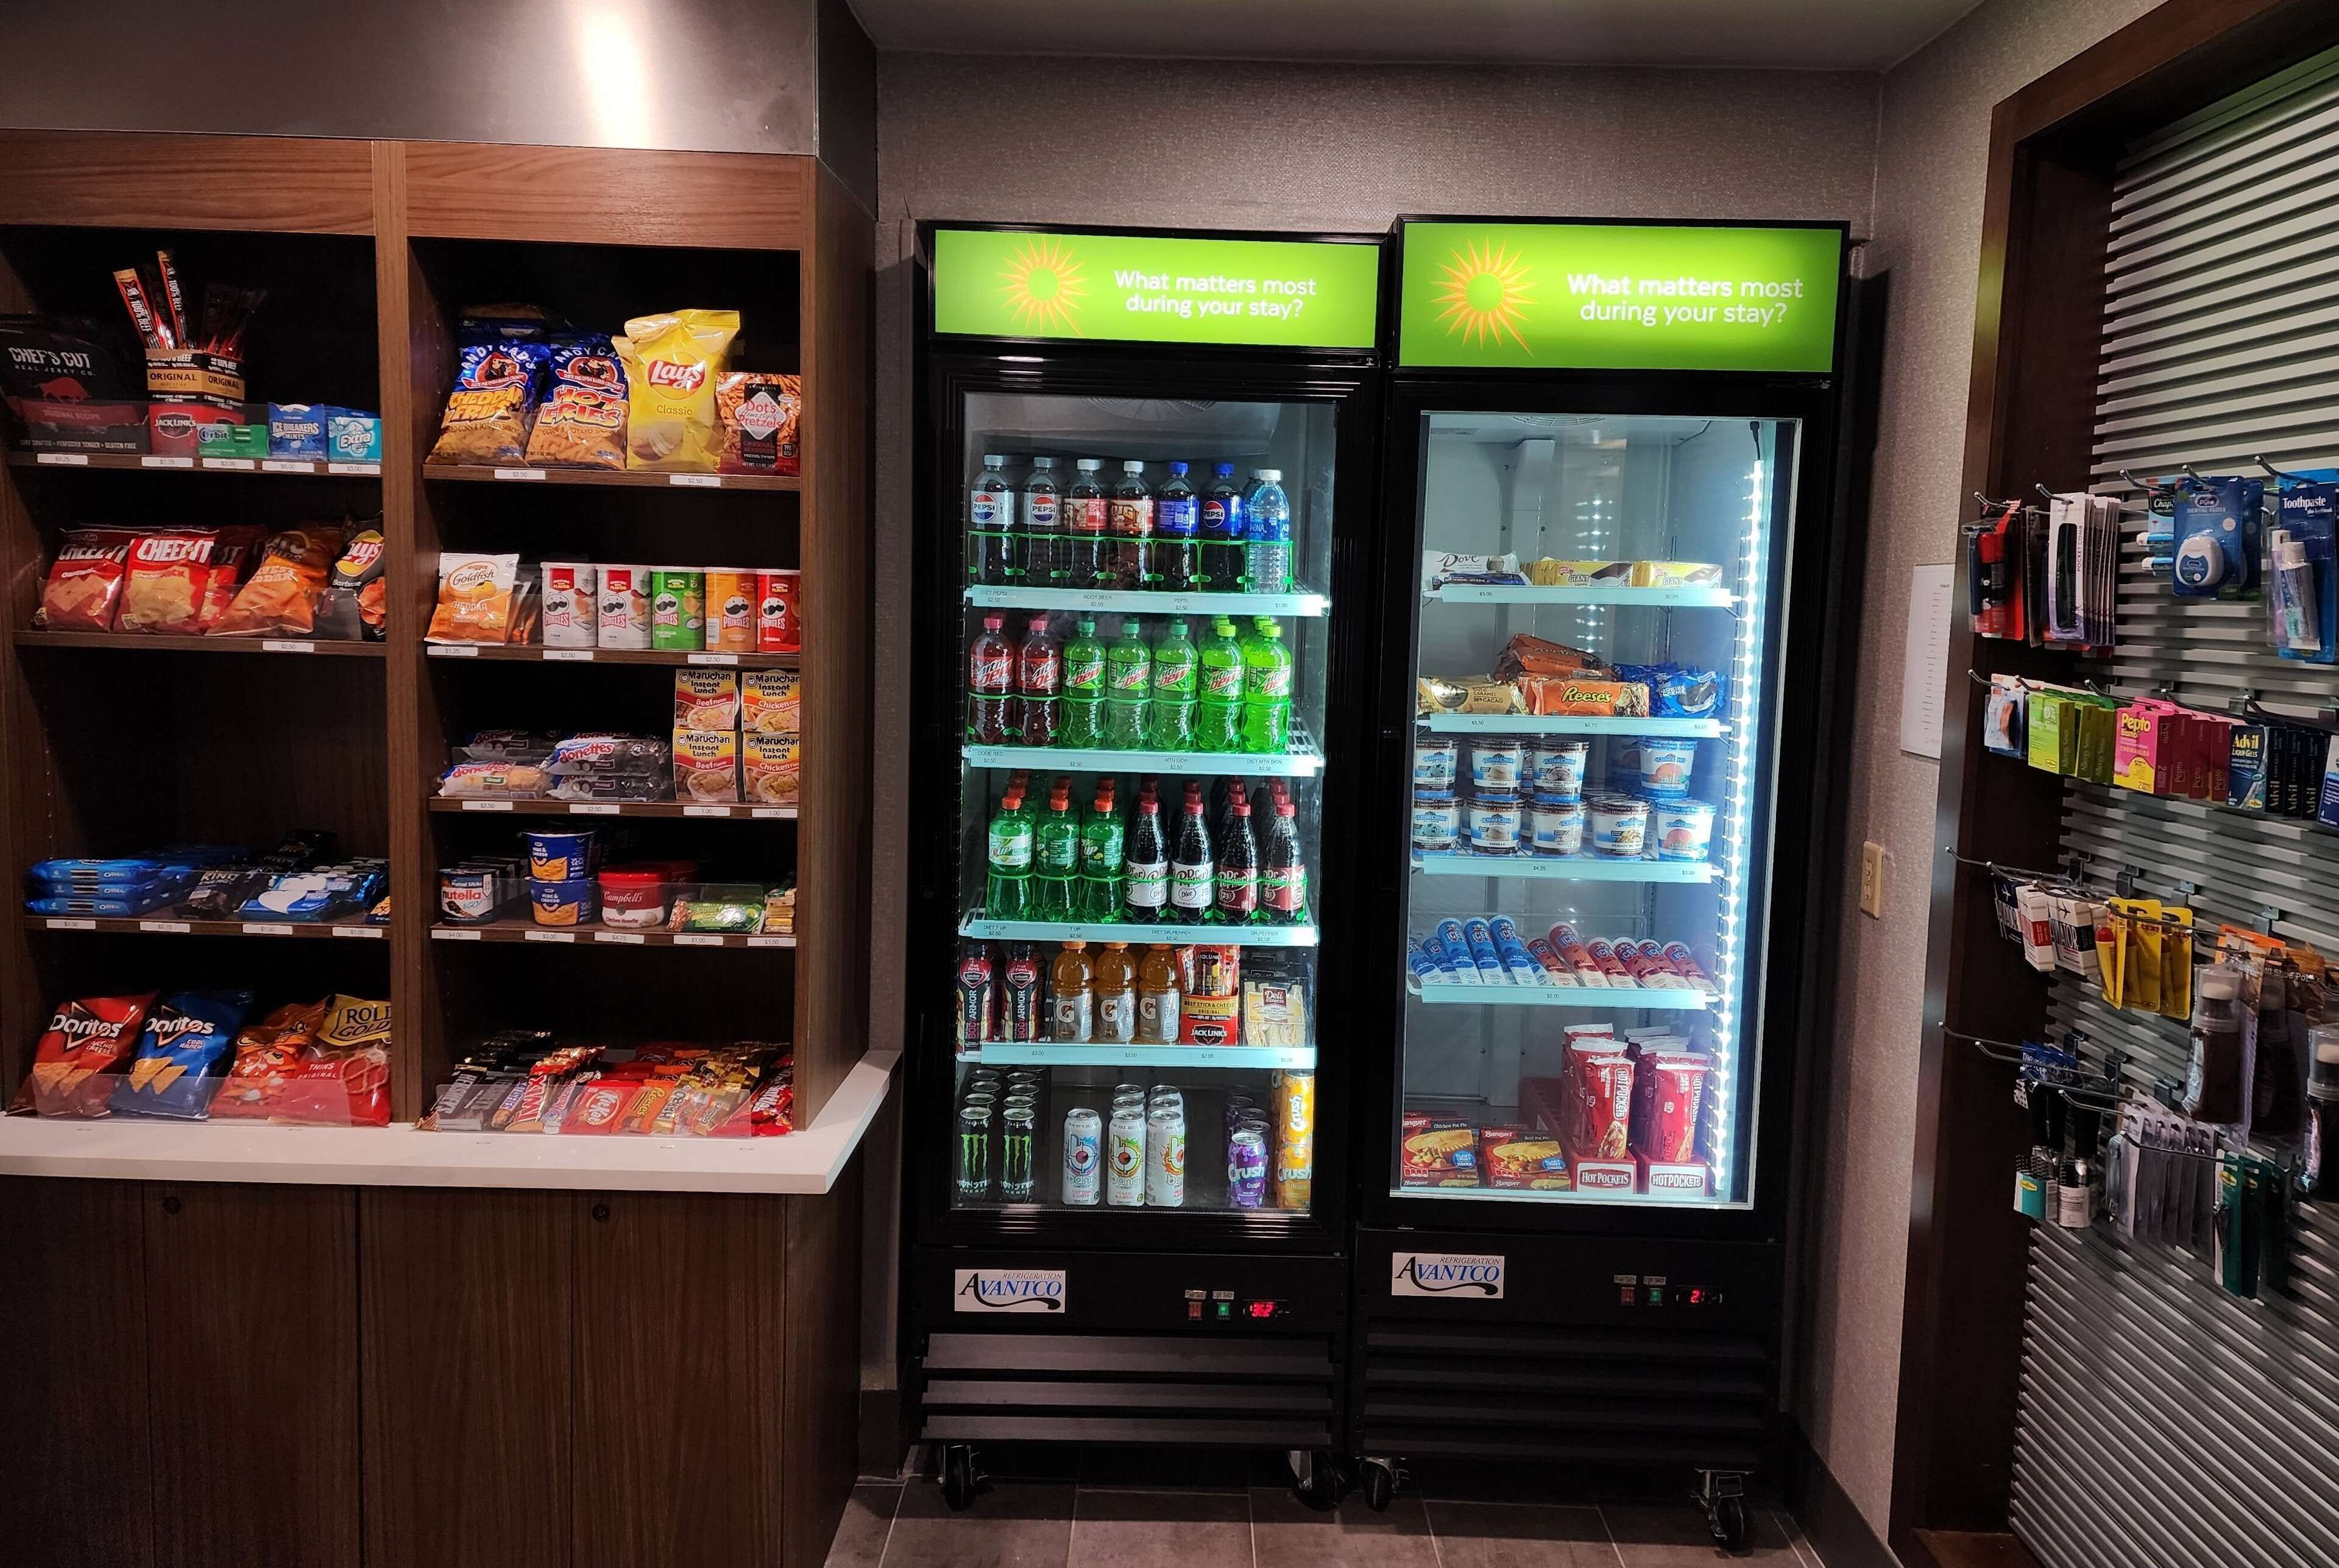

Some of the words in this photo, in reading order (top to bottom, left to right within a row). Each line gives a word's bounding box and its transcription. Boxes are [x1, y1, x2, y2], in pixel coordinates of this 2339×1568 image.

[1114, 270, 1169, 291] What
[1175, 276, 1256, 294] matters
[1262, 280, 1317, 295] most
[1567, 273, 1631, 297] What
[1638, 276, 1733, 298] matters
[1740, 278, 1803, 299] most
[1126, 297, 1191, 319] during
[1197, 302, 1243, 319] your
[1248, 298, 1304, 320] stay?
[1579, 300, 1657, 327] during
[1665, 305, 1720, 325] your
[1723, 302, 1788, 328] stay?
[9, 347, 60, 366] CHEF'S
[61, 352, 91, 369] CUT
[554, 347, 591, 363] ANDY
[44, 367, 75, 375] JERKY
[150, 373, 197, 381] ORIGINAL
[208, 375, 239, 389] ORIGINAL
[448, 385, 526, 409] CHEDDAR
[554, 386, 621, 411] HOT
[540, 401, 623, 428] FRIES
[656, 404, 693, 416] Classic
[745, 399, 777, 415] Dot's
[272, 422, 283, 433] ICE
[283, 422, 319, 435] BREAKERS
[737, 414, 782, 429] Pretzels
[199, 427, 229, 443] Orbit
[340, 432, 372, 448] Extra
[974, 503, 995, 512] PEPSI
[2282, 495, 2327, 510] Toothpaste
[137, 539, 214, 563] CHEEZ-IT
[1438, 554, 1480, 567] Dove
[453, 570, 495, 585] Goldfish
[1568, 574, 1590, 583] GIANT
[1662, 577, 1683, 585] GIANT
[451, 601, 487, 612] CHEDDAR
[723, 616, 750, 629] PRINGLES
[762, 618, 785, 629] PRINGLES
[690, 671, 731, 681] Maruchan
[1562, 685, 1612, 704] Reese's
[758, 700, 790, 710] Chicken
[2121, 712, 2152, 733] Pepto
[686, 734, 730, 744] Maruchan
[2232, 733, 2260, 749] Advil
[559, 743, 614, 764] donettes
[759, 762, 790, 772] Chicken
[1188, 869, 1200, 878] Dr
[442, 889, 481, 900] nutella
[604, 890, 643, 903] Campbell's
[1265, 991, 1284, 1000] Deli
[968, 989, 977, 1040] BODYARMOR
[1016, 989, 1026, 1040] BODYARMOR
[1055, 1000, 1075, 1023] G
[1100, 999, 1119, 1022] G
[1139, 997, 1156, 1020] G
[49, 1014, 124, 1039] Doritos
[145, 1015, 215, 1034] Doritos
[339, 1021, 391, 1037] GOLD
[85, 1044, 112, 1054] CHEESE
[89, 1040, 114, 1048] NACHO
[308, 1062, 335, 1072] THINS
[296, 1072, 337, 1082] ORIGINAL
[517, 1075, 547, 1123] TWIX
[636, 1086, 666, 1117] Reese's
[1290, 1095, 1307, 1132] Crush
[1228, 1161, 1265, 1182] Crush
[1277, 1164, 1312, 1182] Crush
[1582, 1172, 1598, 1183] HOT
[1597, 1172, 1630, 1185] POCKETS
[1067, 1176, 1096, 1187] bang
[1111, 1176, 1141, 1187] bang
[1652, 1174, 1667, 1187] HOT
[1666, 1174, 1702, 1188] POCKETS
[1439, 1256, 1501, 1265] REFRIGERATION
[1394, 1255, 1500, 1289] AVANTCO
[957, 1272, 1062, 1304] AVANTCO
